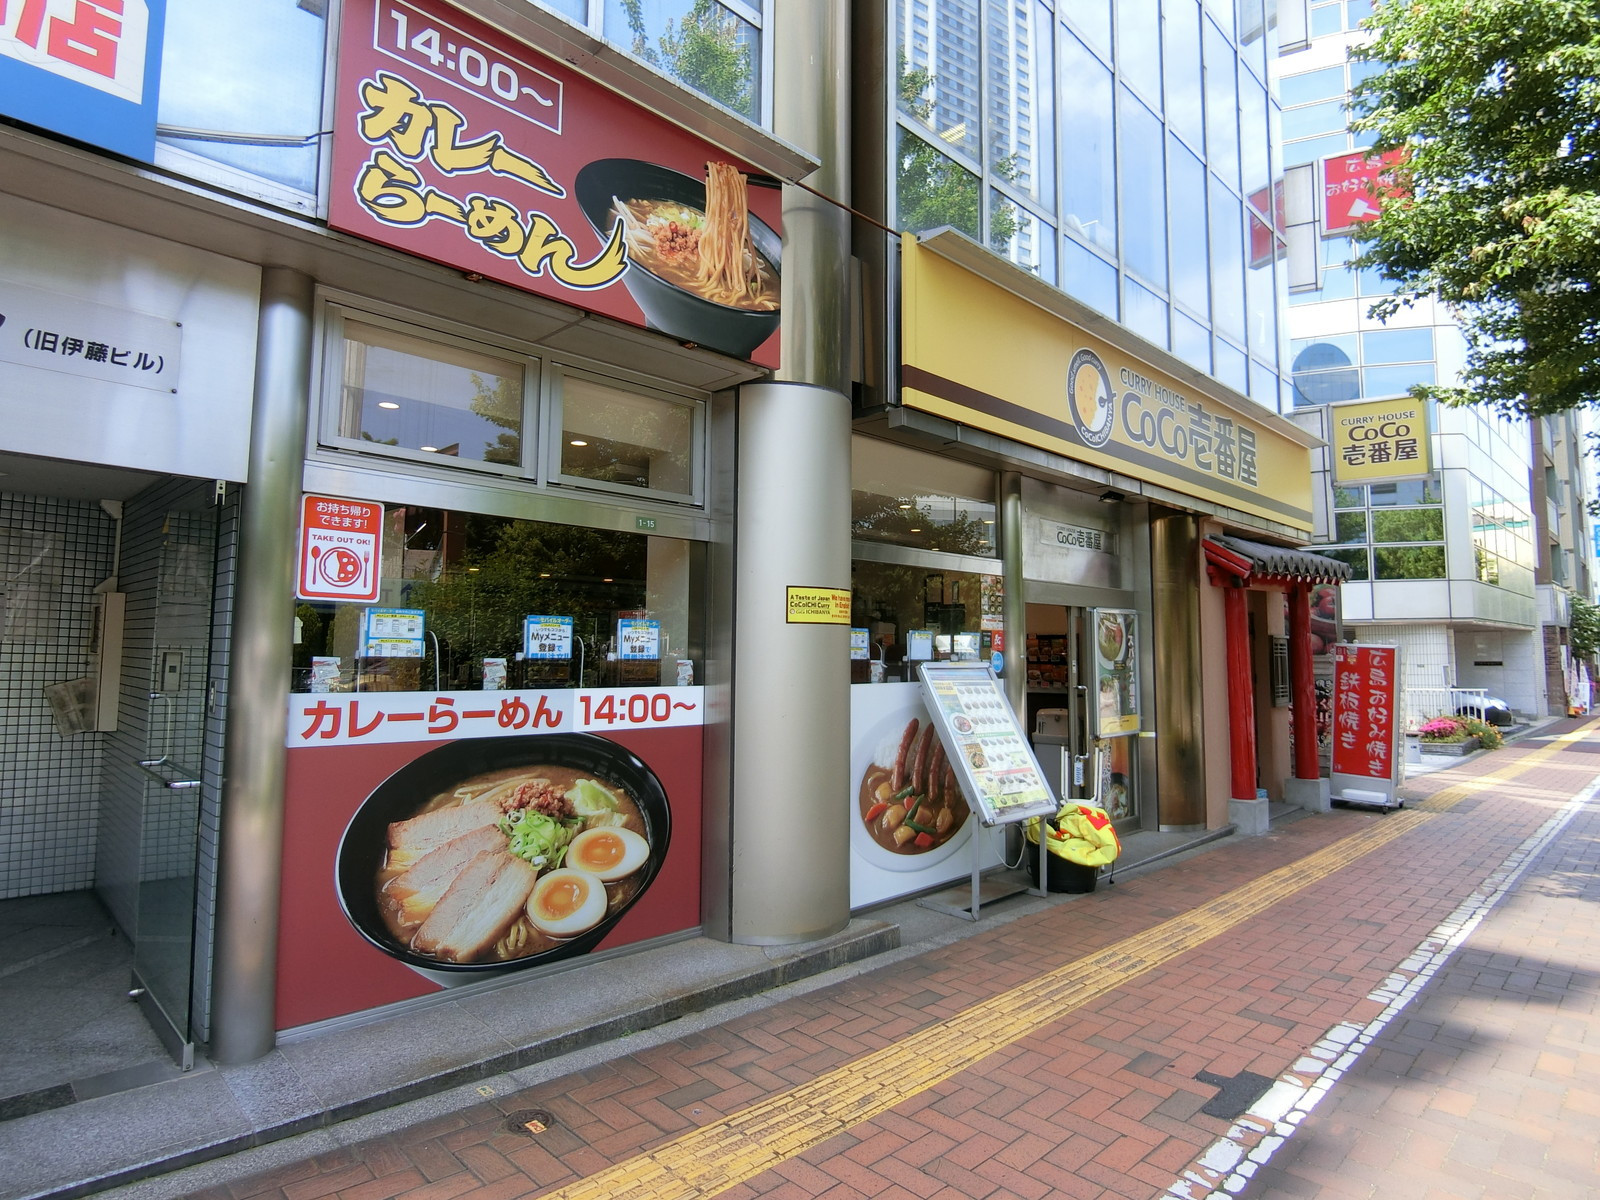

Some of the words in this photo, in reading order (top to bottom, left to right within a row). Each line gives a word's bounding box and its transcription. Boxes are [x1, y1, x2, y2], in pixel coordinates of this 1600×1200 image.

[359, 70, 567, 199] カレー
[1326, 171, 1405, 197] お好み焼
[354, 146, 631, 291] らーめん
[24, 328, 165, 374] (旧伊藤ビル)
[1120, 367, 1152, 396] CURRY
[1154, 383, 1186, 411] HOUSE
[1341, 415, 1375, 426] CURRY
[1378, 410, 1415, 422] HOUSE
[1348, 422, 1410, 441] CoCo
[1342, 438, 1418, 466] 壱番屋
[316, 502, 371, 517] お持ち帰り
[319, 514, 368, 529] できます!
[639, 519, 655, 528] 1-15
[312, 534, 335, 542] TAKE
[531, 631, 570, 643] Myメニュー
[623, 634, 657, 645] Myメニュー
[301, 695, 563, 740] カレーらーめん
[1338, 671, 1361, 749] 鉄板焼き
[1366, 649, 1388, 776] 広島お好み焼き
